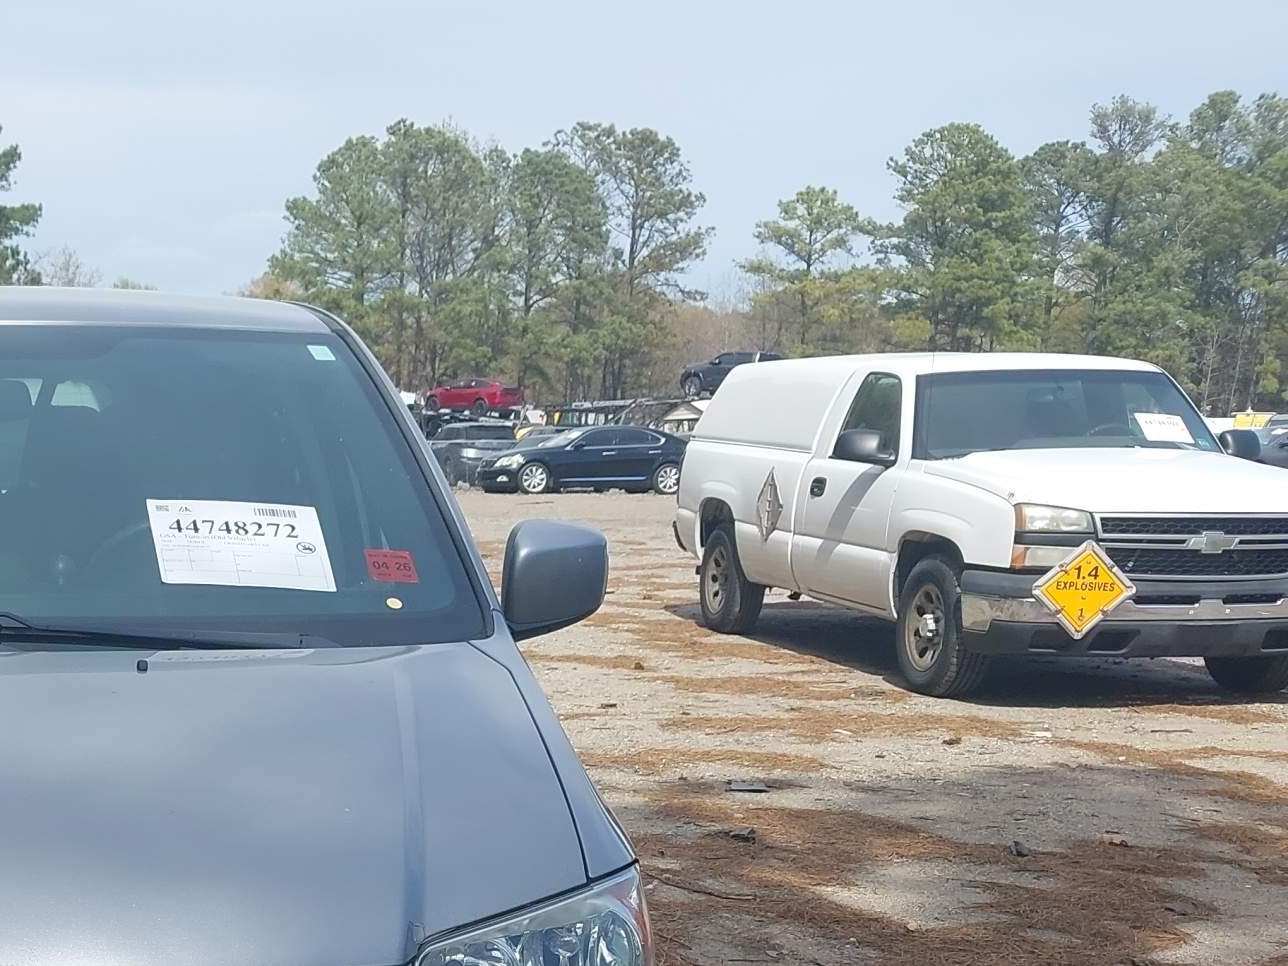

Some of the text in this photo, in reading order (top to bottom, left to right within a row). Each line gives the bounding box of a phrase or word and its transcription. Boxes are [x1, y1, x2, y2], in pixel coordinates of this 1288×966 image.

[169, 517, 299, 540] 44748272
[372, 560, 389, 570] 04
[1074, 565, 1100, 580] 1.4
[1055, 580, 1116, 592] EXPLOSIVES
[1078, 607, 1085, 618] 1
